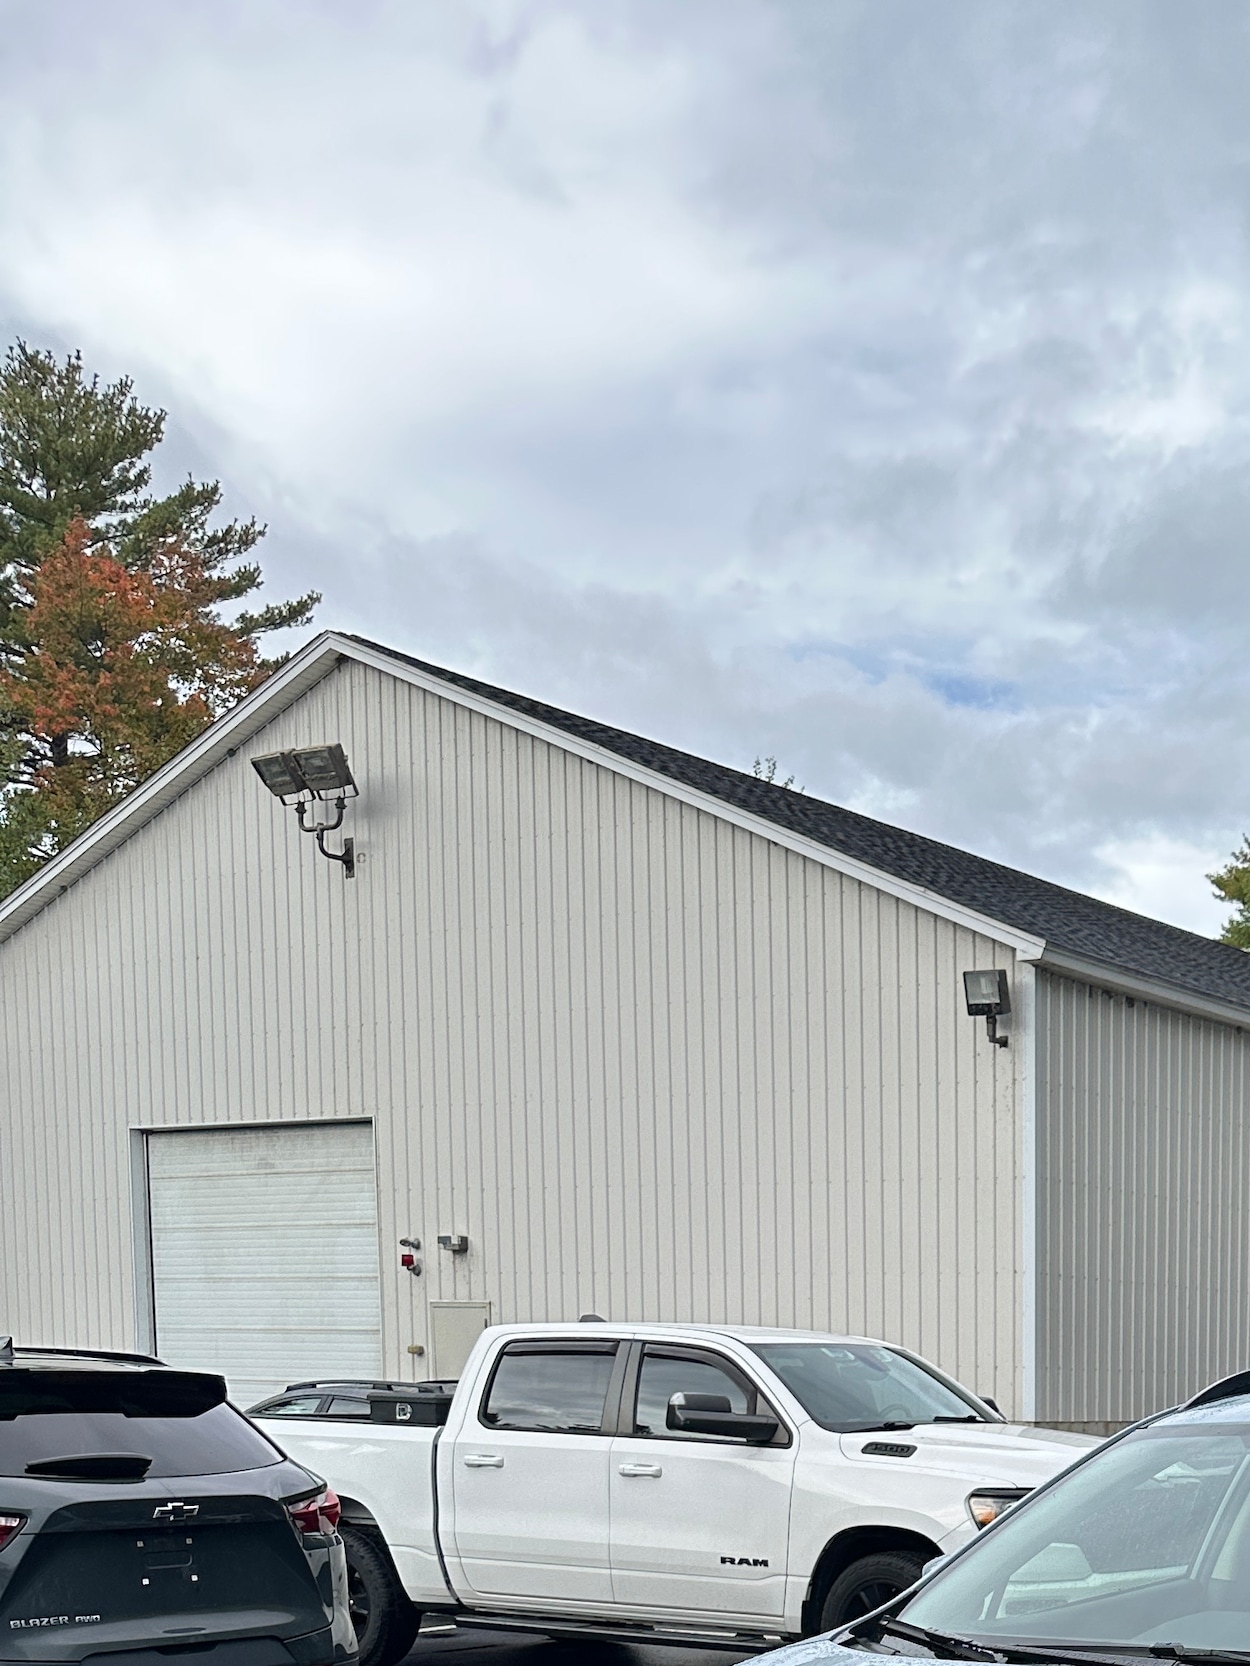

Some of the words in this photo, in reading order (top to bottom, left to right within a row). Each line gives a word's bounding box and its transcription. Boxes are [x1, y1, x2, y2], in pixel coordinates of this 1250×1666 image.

[720, 1556, 769, 1567] RAM
[9, 1615, 69, 1629] BLAZER
[75, 1614, 101, 1623] AWD
